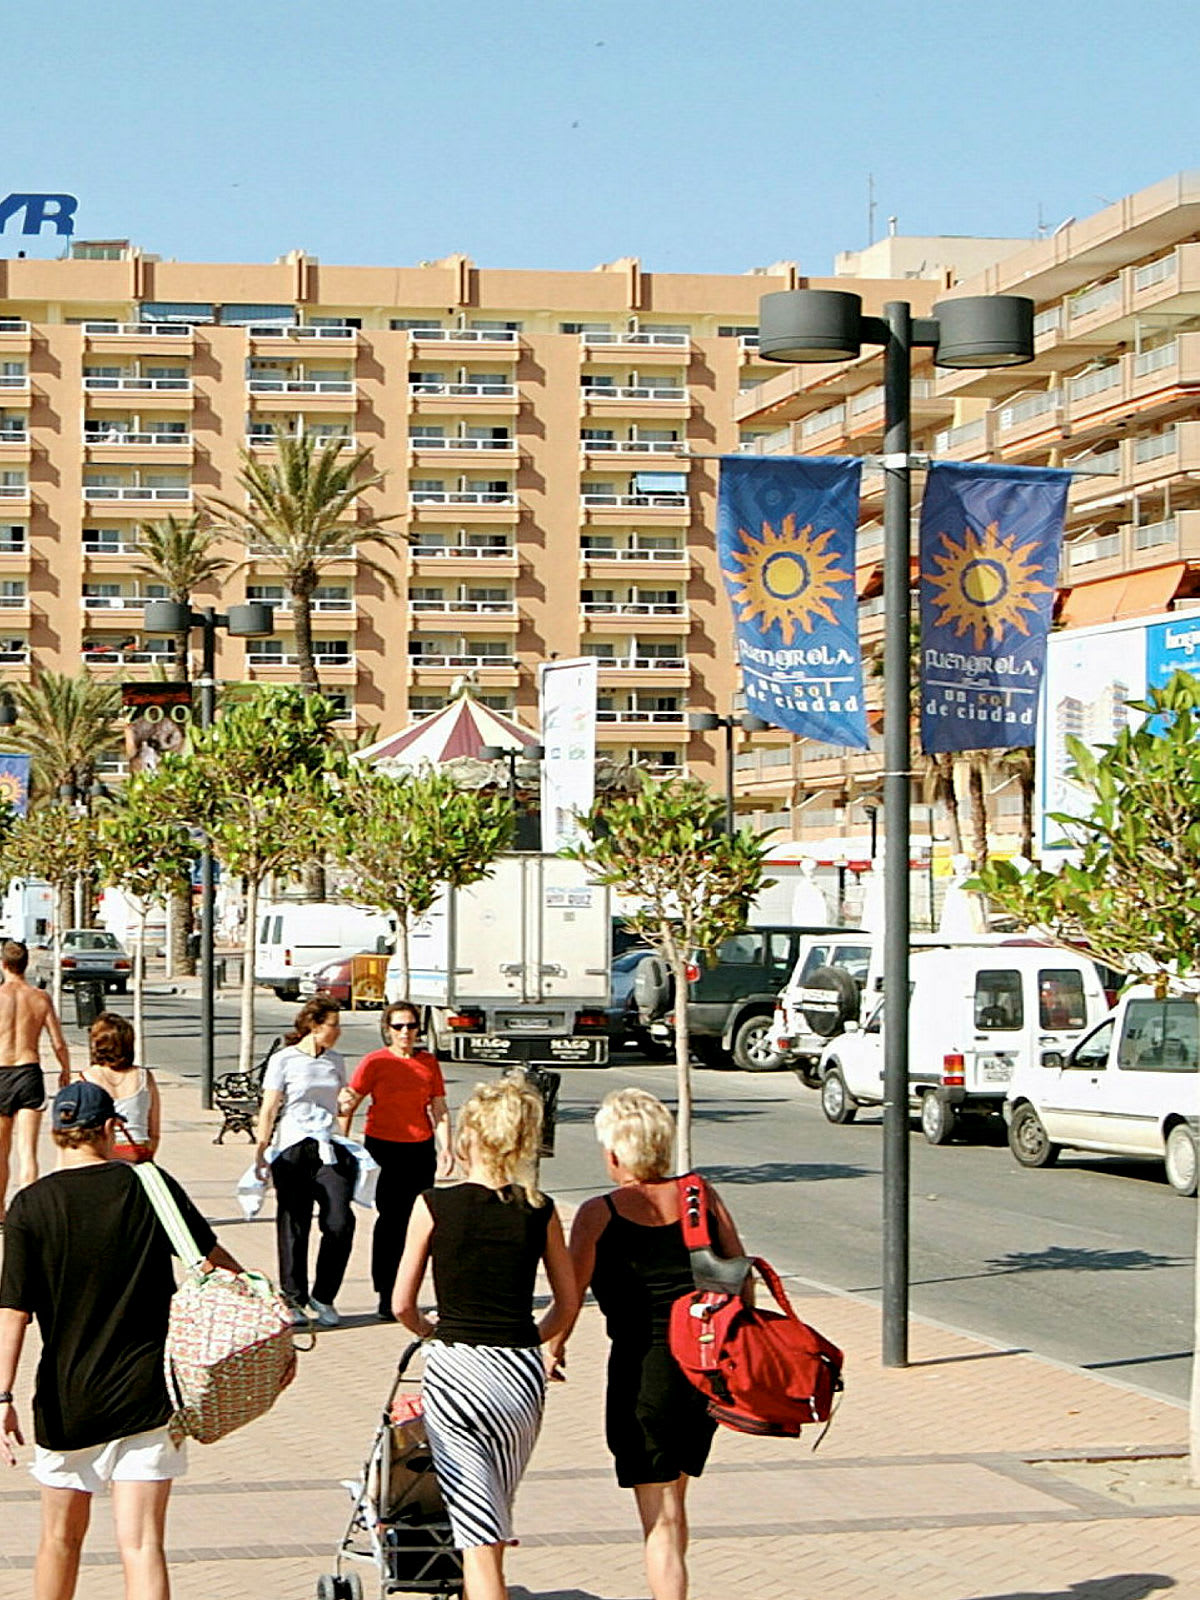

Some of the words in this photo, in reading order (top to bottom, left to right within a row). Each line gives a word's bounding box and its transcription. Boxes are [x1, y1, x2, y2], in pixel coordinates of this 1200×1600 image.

[774, 695, 859, 712] ciudad
[944, 689, 967, 703] un
[978, 691, 1012, 708] sol
[926, 699, 950, 717] de
[956, 703, 1033, 725] ciudad
